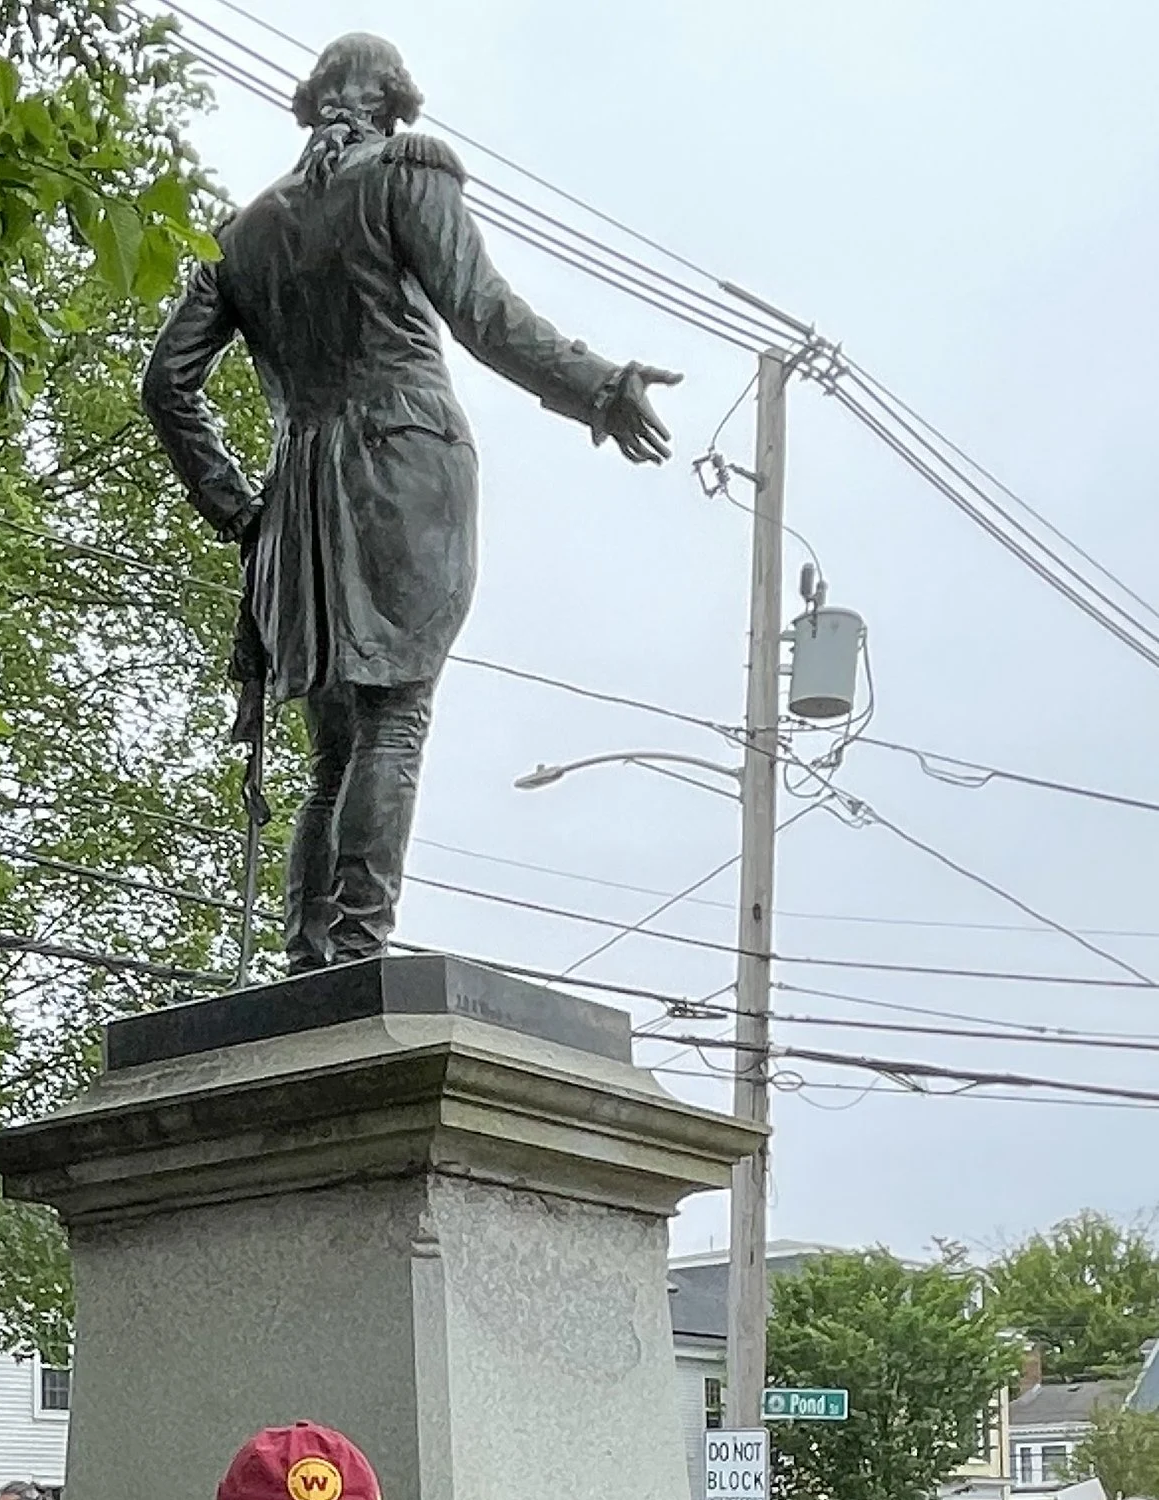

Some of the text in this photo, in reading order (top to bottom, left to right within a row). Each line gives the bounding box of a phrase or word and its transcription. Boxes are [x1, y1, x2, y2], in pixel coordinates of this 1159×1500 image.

[790, 1393, 826, 1415] Pond
[708, 1442, 763, 1462] DO NOT
[299, 1474, 329, 1492] W
[707, 1471, 764, 1491] BLOCK
